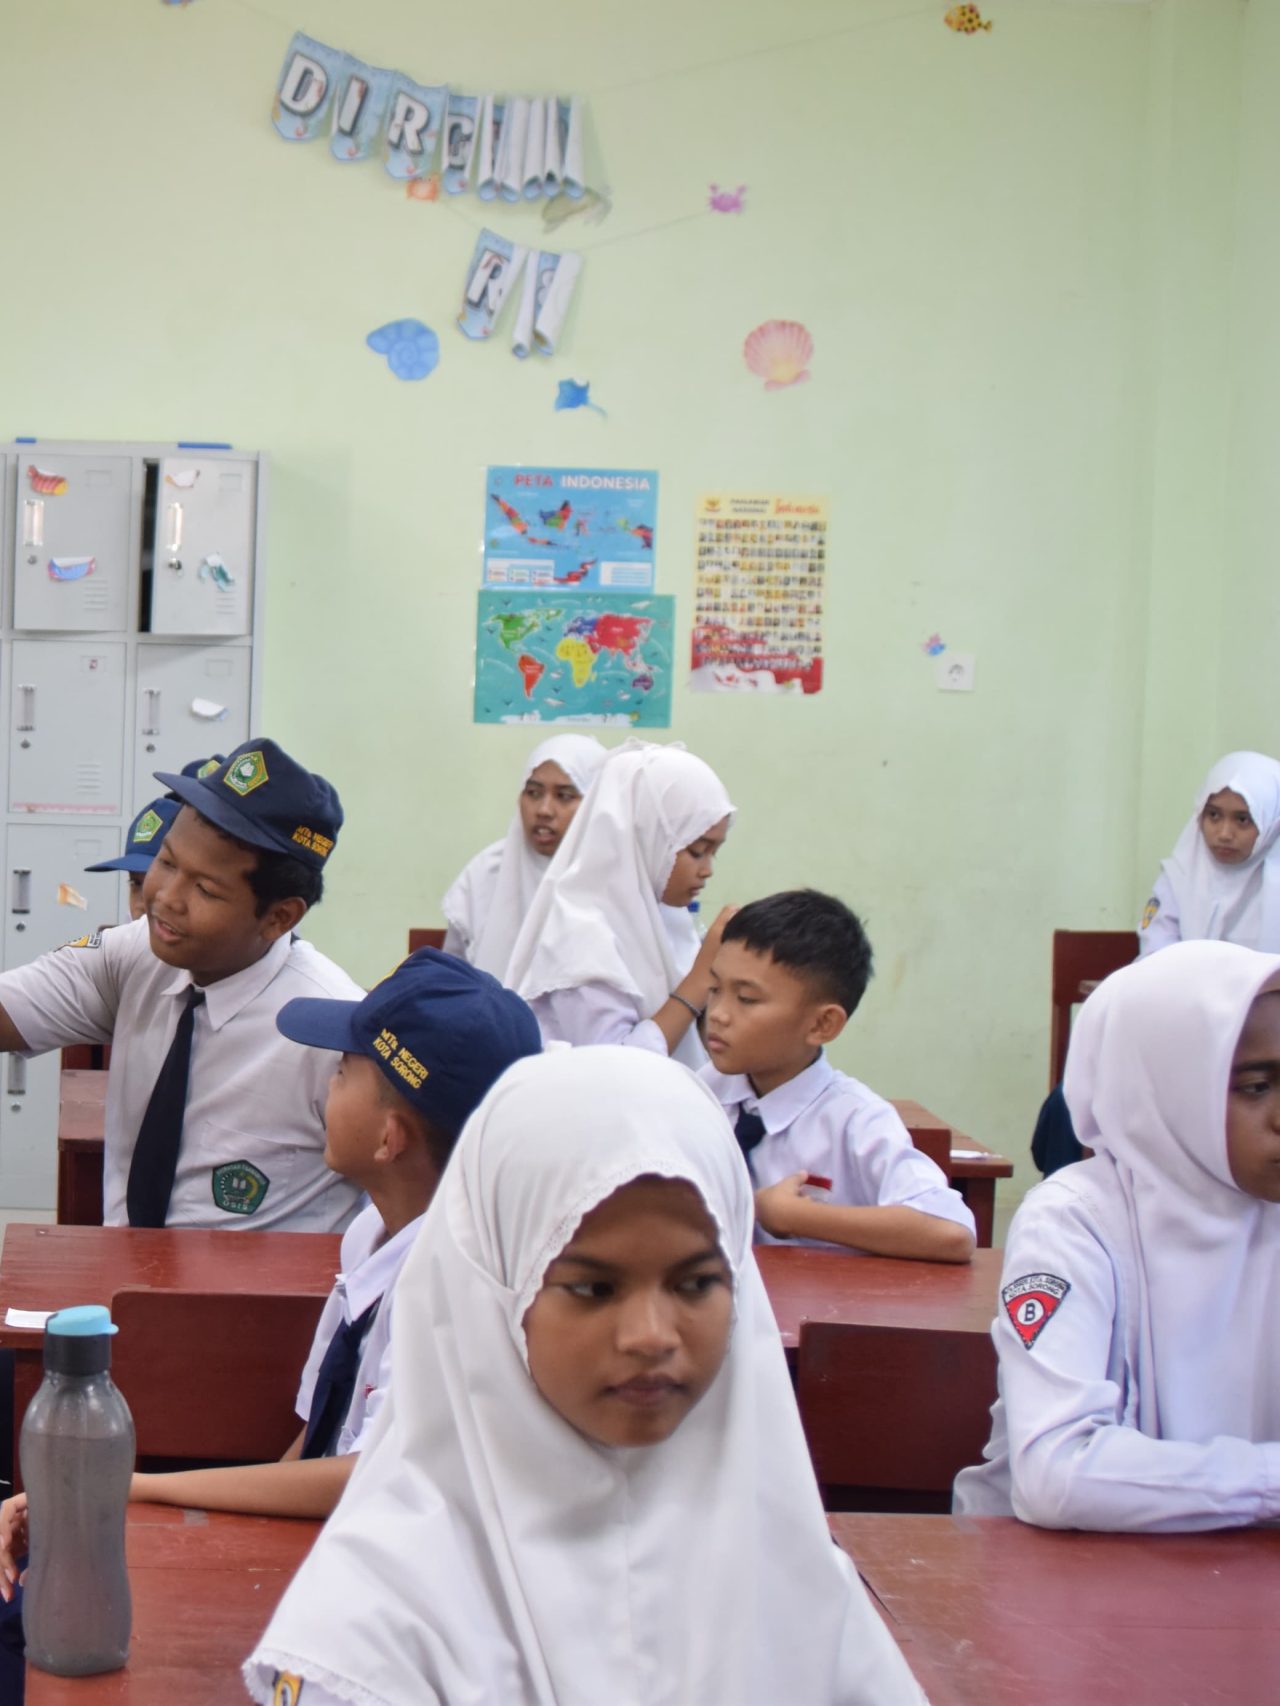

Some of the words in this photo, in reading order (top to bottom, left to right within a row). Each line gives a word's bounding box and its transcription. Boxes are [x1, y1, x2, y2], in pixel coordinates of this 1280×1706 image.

[514, 474, 553, 487] PETA
[561, 475, 650, 490] INDONESIA
[373, 1036, 391, 1060] KOTA
[390, 1056, 422, 1089] SORONG
[398, 1047, 429, 1080] NEGERI
[1024, 1302, 1036, 1322] B
